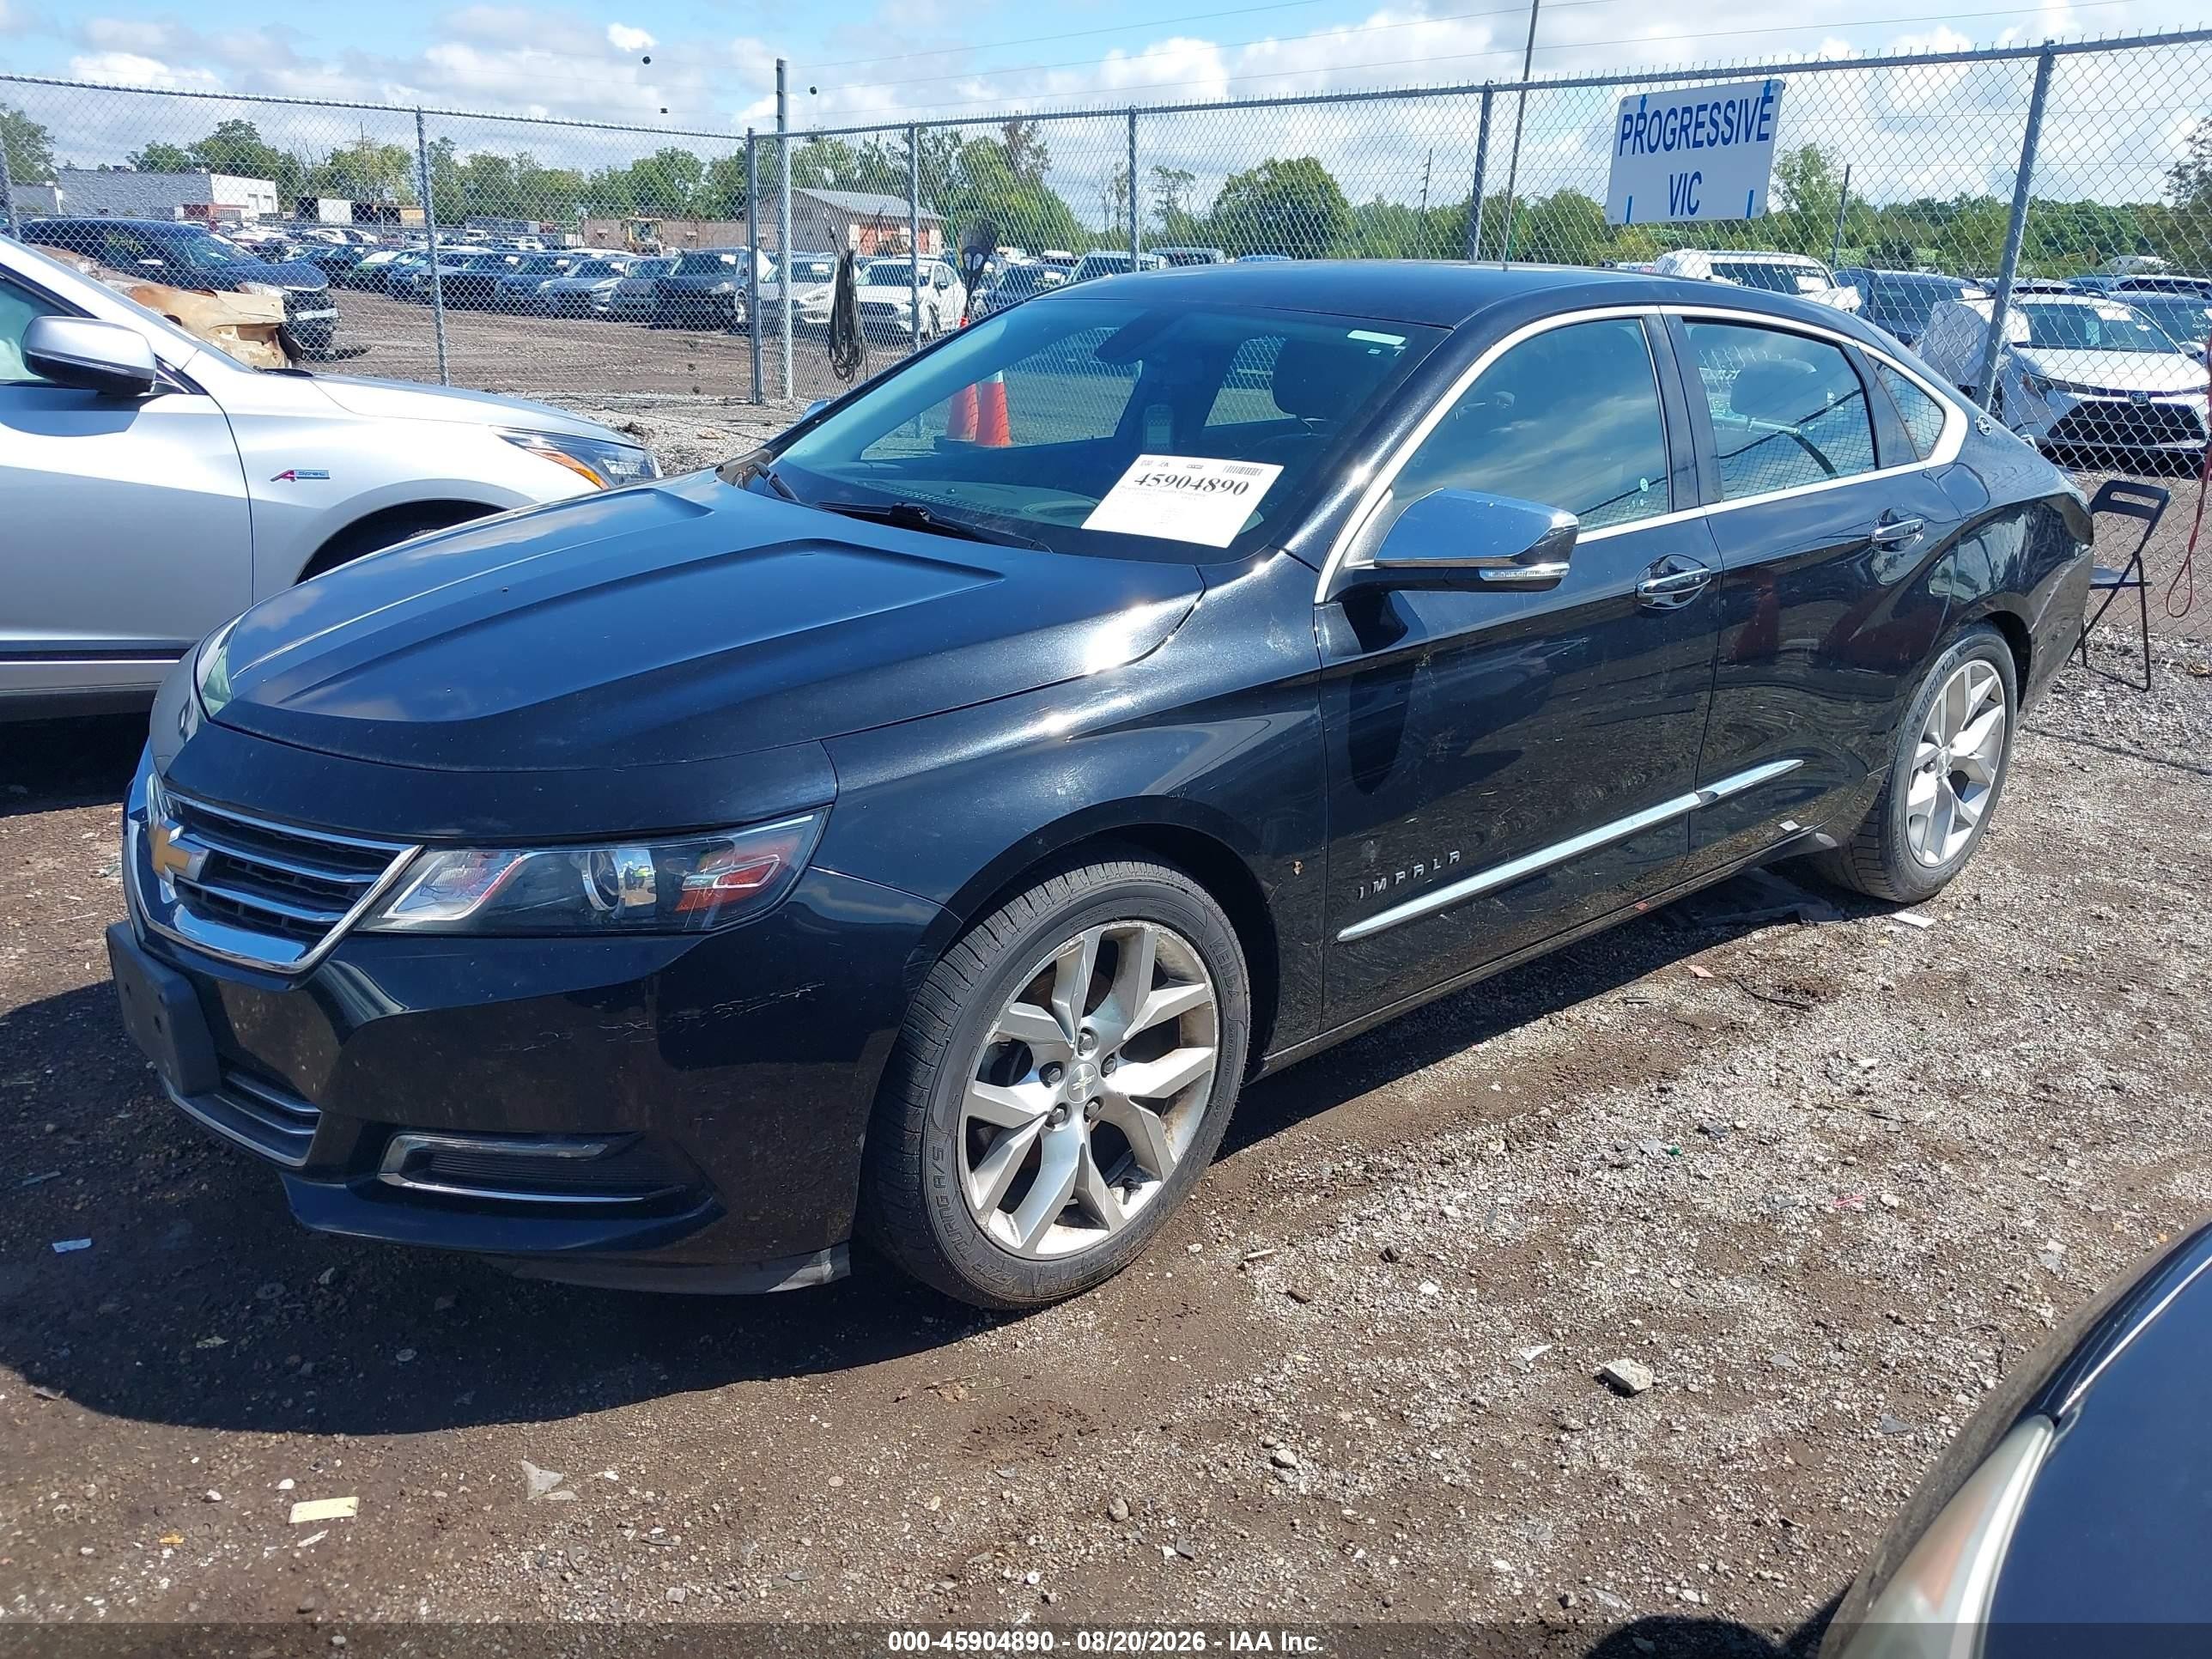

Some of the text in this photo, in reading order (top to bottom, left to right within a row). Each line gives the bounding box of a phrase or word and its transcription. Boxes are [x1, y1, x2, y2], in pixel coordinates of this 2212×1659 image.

[1619, 95, 1774, 156] PROGRESSIVE
[1669, 171, 1702, 216] VIC
[1133, 472, 1249, 495] 45904890
[1358, 850, 1461, 899] IMPALA
[1209, 935, 1240, 1001] KENDA
[932, 1145, 947, 1188] A/S
[935, 1194, 975, 1261] TOURING
